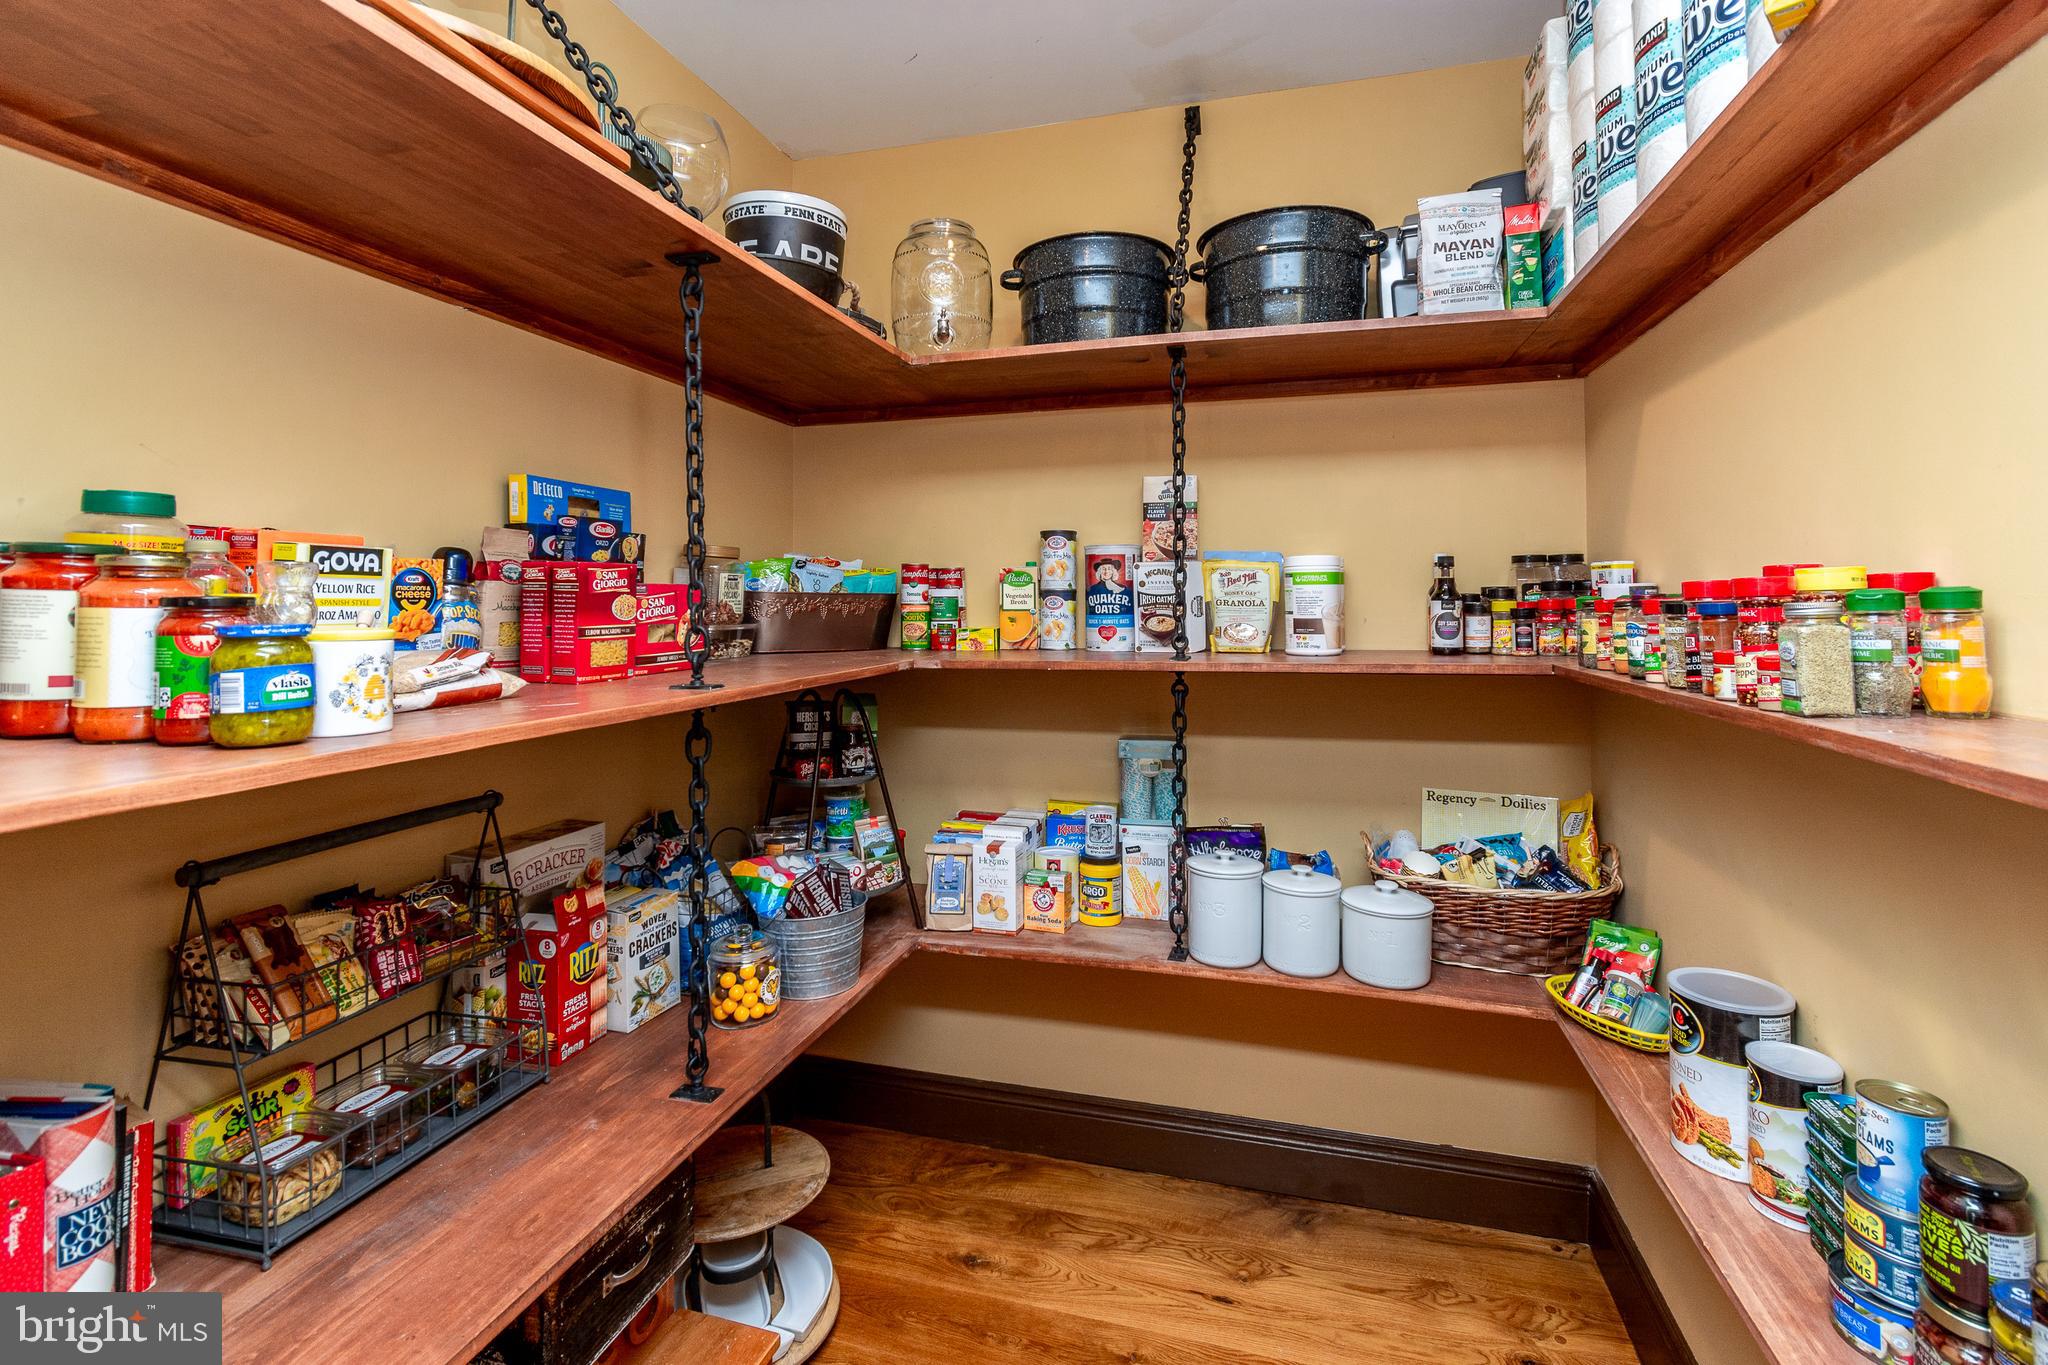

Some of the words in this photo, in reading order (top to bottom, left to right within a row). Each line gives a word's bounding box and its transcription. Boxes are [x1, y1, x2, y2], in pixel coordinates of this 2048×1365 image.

[735, 205, 765, 218] STATE
[784, 206, 814, 220] PENN
[817, 214, 842, 233] STATE
[1433, 237, 1495, 254] MAYAN
[1445, 250, 1484, 262] BLEND
[1432, 288, 1454, 297] WHOLE
[1456, 286, 1473, 294] BEAN
[1474, 283, 1496, 292] COFFEE
[543, 482, 563, 499] CECCO
[595, 525, 614, 534] Barilla
[313, 550, 380, 573] GOYA
[602, 571, 618, 580] SAN
[1008, 574, 1030, 582] Pacific
[1226, 577, 1242, 588] Red
[1242, 572, 1257, 584] Mill
[315, 582, 354, 594] YELLOW
[356, 583, 376, 594] RICE
[593, 579, 628, 591] GIORGIO
[648, 598, 665, 608] SAN
[1088, 593, 1128, 607] QUAKER
[1140, 594, 1155, 606] IRISH
[1215, 599, 1266, 607] GRANOLA
[637, 605, 675, 620] GIORGIO
[1095, 604, 1120, 614] OATS
[272, 692, 286, 701] Dill
[288, 690, 309, 700] Relish
[1426, 790, 1477, 807] Regency
[1501, 796, 1547, 811] Doilies
[514, 870, 524, 887] 6
[525, 848, 586, 881] CRACKER
[1142, 857, 1166, 867] STARCH
[531, 872, 572, 893] ASSORTMENT
[979, 876, 1008, 885] SCONE
[1083, 886, 1104, 896] ARGO
[596, 921, 601, 931] 8
[641, 913, 667, 930] WOVEN
[1026, 915, 1046, 923] Baking
[544, 941, 551, 950] 8
[629, 921, 677, 958] CRACKERS
[1595, 935, 1627, 950] Knorr
[569, 942, 599, 982] RITZ
[563, 997, 588, 1017] STACKS
[565, 991, 587, 1009] FRESH
[565, 1017, 586, 1032] original
[1760, 1017, 1780, 1025] Nutrition
[1870, 1109, 1889, 1125] Sea
[1857, 1124, 1894, 1155] CLAMS
[70, 1198, 112, 1228] NEW
[1990, 1236, 2020, 1244] Nutrition
[1990, 1241, 2009, 1249] Facts
[1840, 1307, 1868, 1333] BREAST
